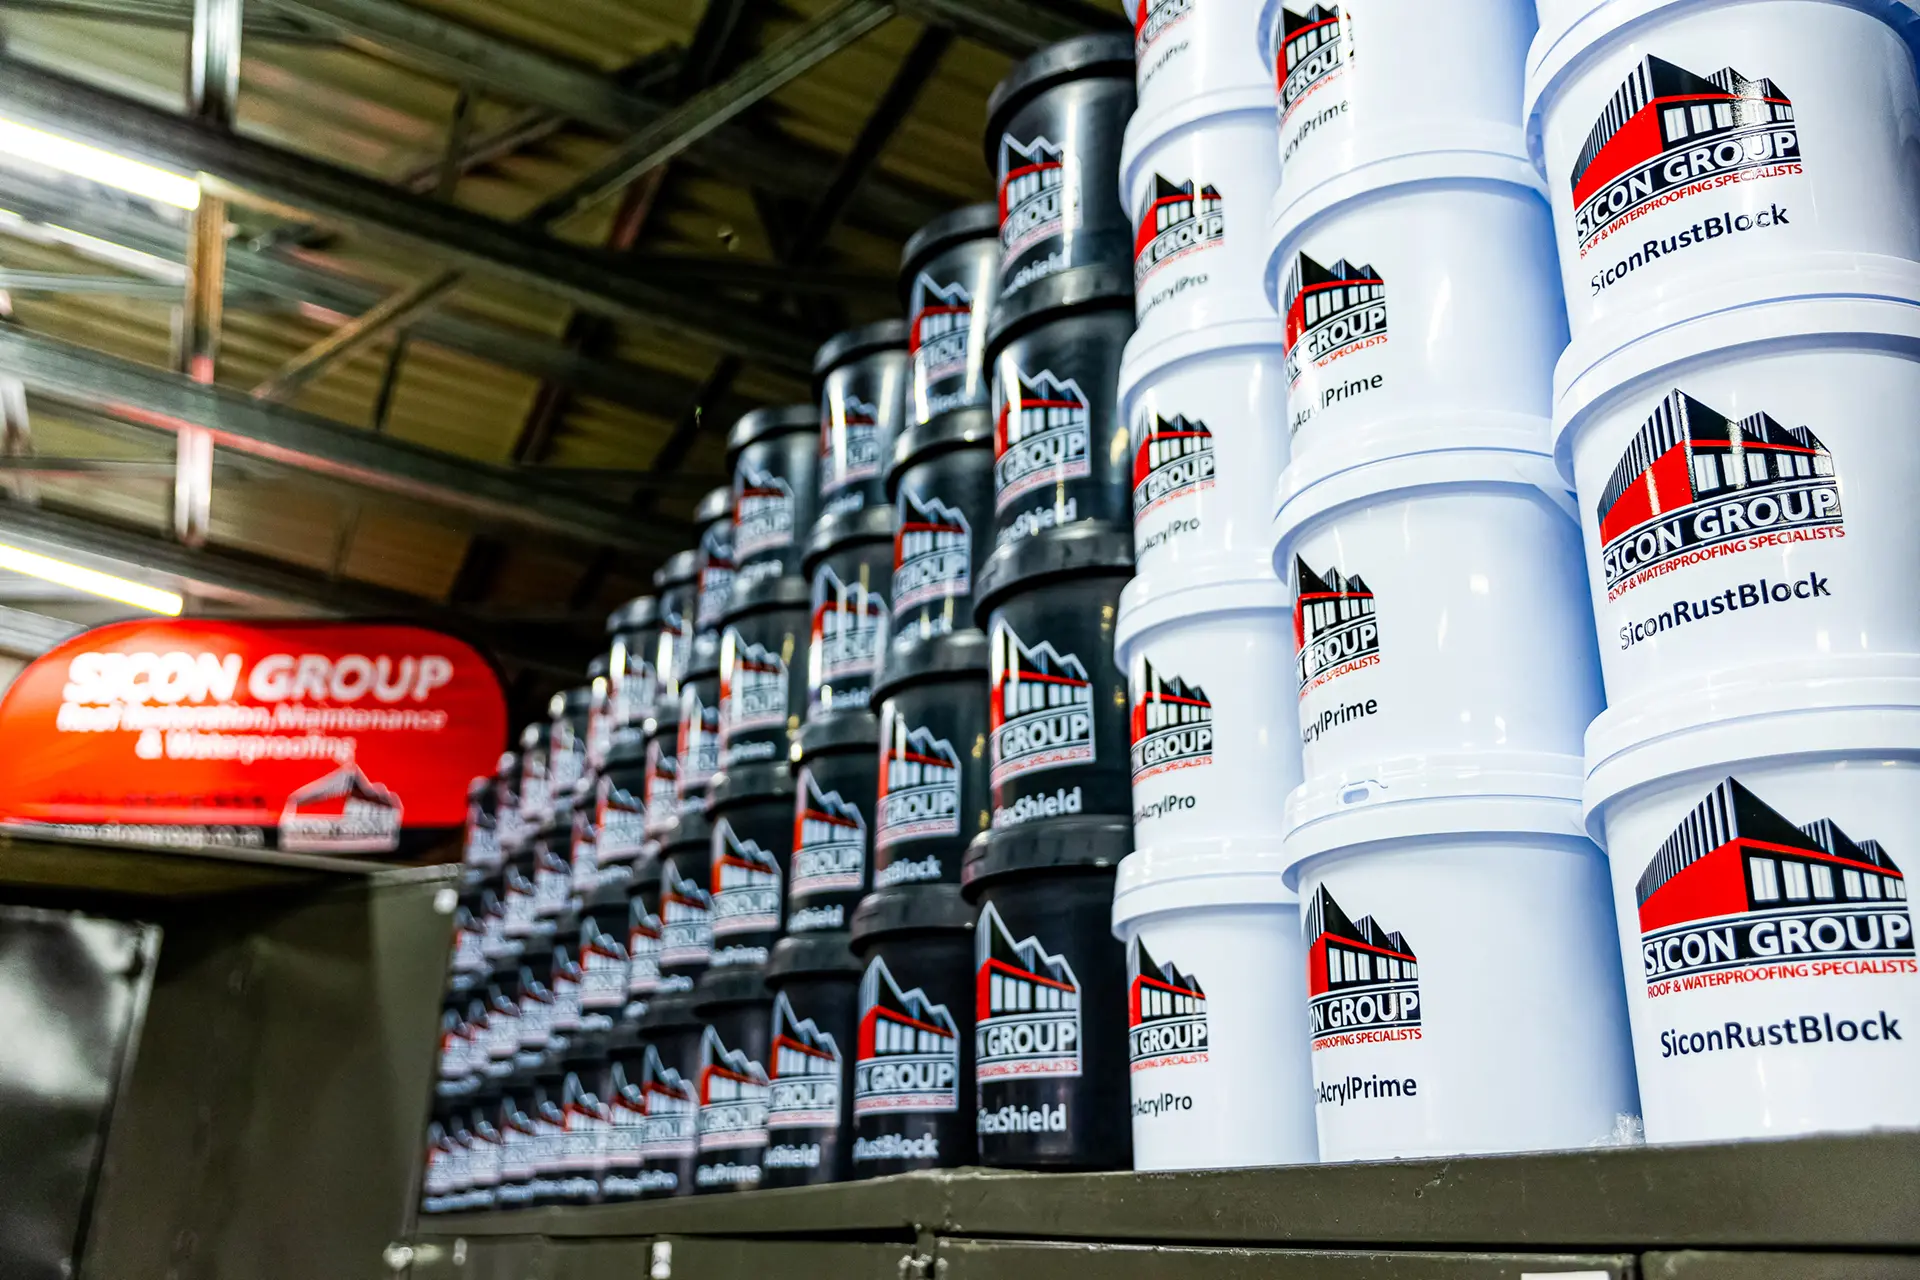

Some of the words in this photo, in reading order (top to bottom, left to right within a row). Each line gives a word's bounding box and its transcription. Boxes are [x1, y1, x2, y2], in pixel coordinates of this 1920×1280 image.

[1575, 168, 1654, 242] SICON
[1662, 131, 1798, 185] GROUP
[1608, 178, 1714, 238] WATERPROOFING
[1154, 216, 1224, 261] GROUP
[1591, 203, 1791, 297] SiconRustBlock
[1307, 306, 1387, 358] GROUP
[1003, 431, 1086, 482] GROUP
[1148, 455, 1215, 501] GROUP
[1604, 523, 1684, 581] SICON
[1693, 488, 1838, 540] GROUP
[1607, 583, 1629, 605] ROOF
[1636, 540, 1748, 586] WATERPROOFING
[1748, 524, 1847, 550] SPECIALISTS
[1620, 571, 1832, 651] SiconRustBlock
[63, 652, 243, 704] SICON
[248, 653, 454, 703] GROUP
[1002, 713, 1090, 758] GROUP
[1144, 727, 1212, 763] GROUP
[1642, 926, 1738, 977] SICON
[1748, 913, 1910, 957] GROUP
[1647, 982, 1672, 999] ROOF
[1673, 980, 1682, 993] &
[1681, 962, 1809, 991] WATERPROOFING
[1811, 958, 1918, 977] SPECIALISTS
[1328, 991, 1419, 1028] GROUP
[1660, 1010, 1904, 1058] SiconRustBlock
[986, 1021, 1077, 1056] GROUP
[1139, 1022, 1208, 1054] GROUP
[1355, 1028, 1422, 1044] SPECIALISTS
